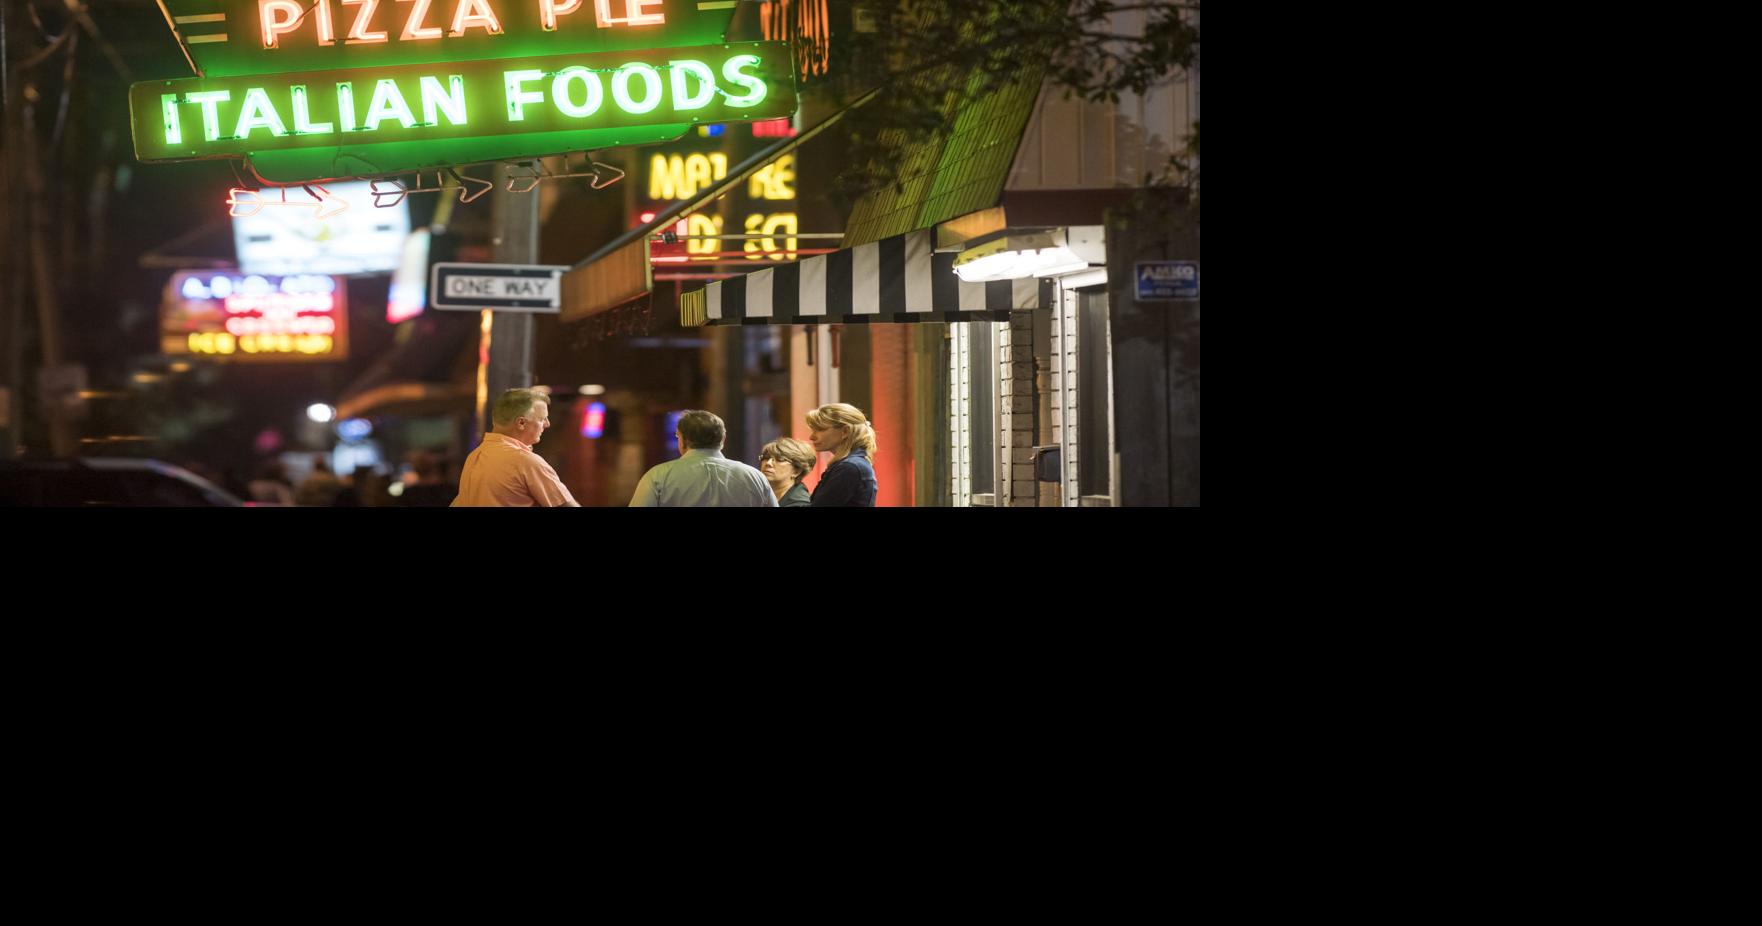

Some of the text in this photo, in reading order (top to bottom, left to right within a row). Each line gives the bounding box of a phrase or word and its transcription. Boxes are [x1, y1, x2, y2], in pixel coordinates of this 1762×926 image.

[259, 0, 504, 49] PIZZA
[161, 54, 768, 145] ITALIAN FOODS
[451, 278, 547, 296] ONE WAY
